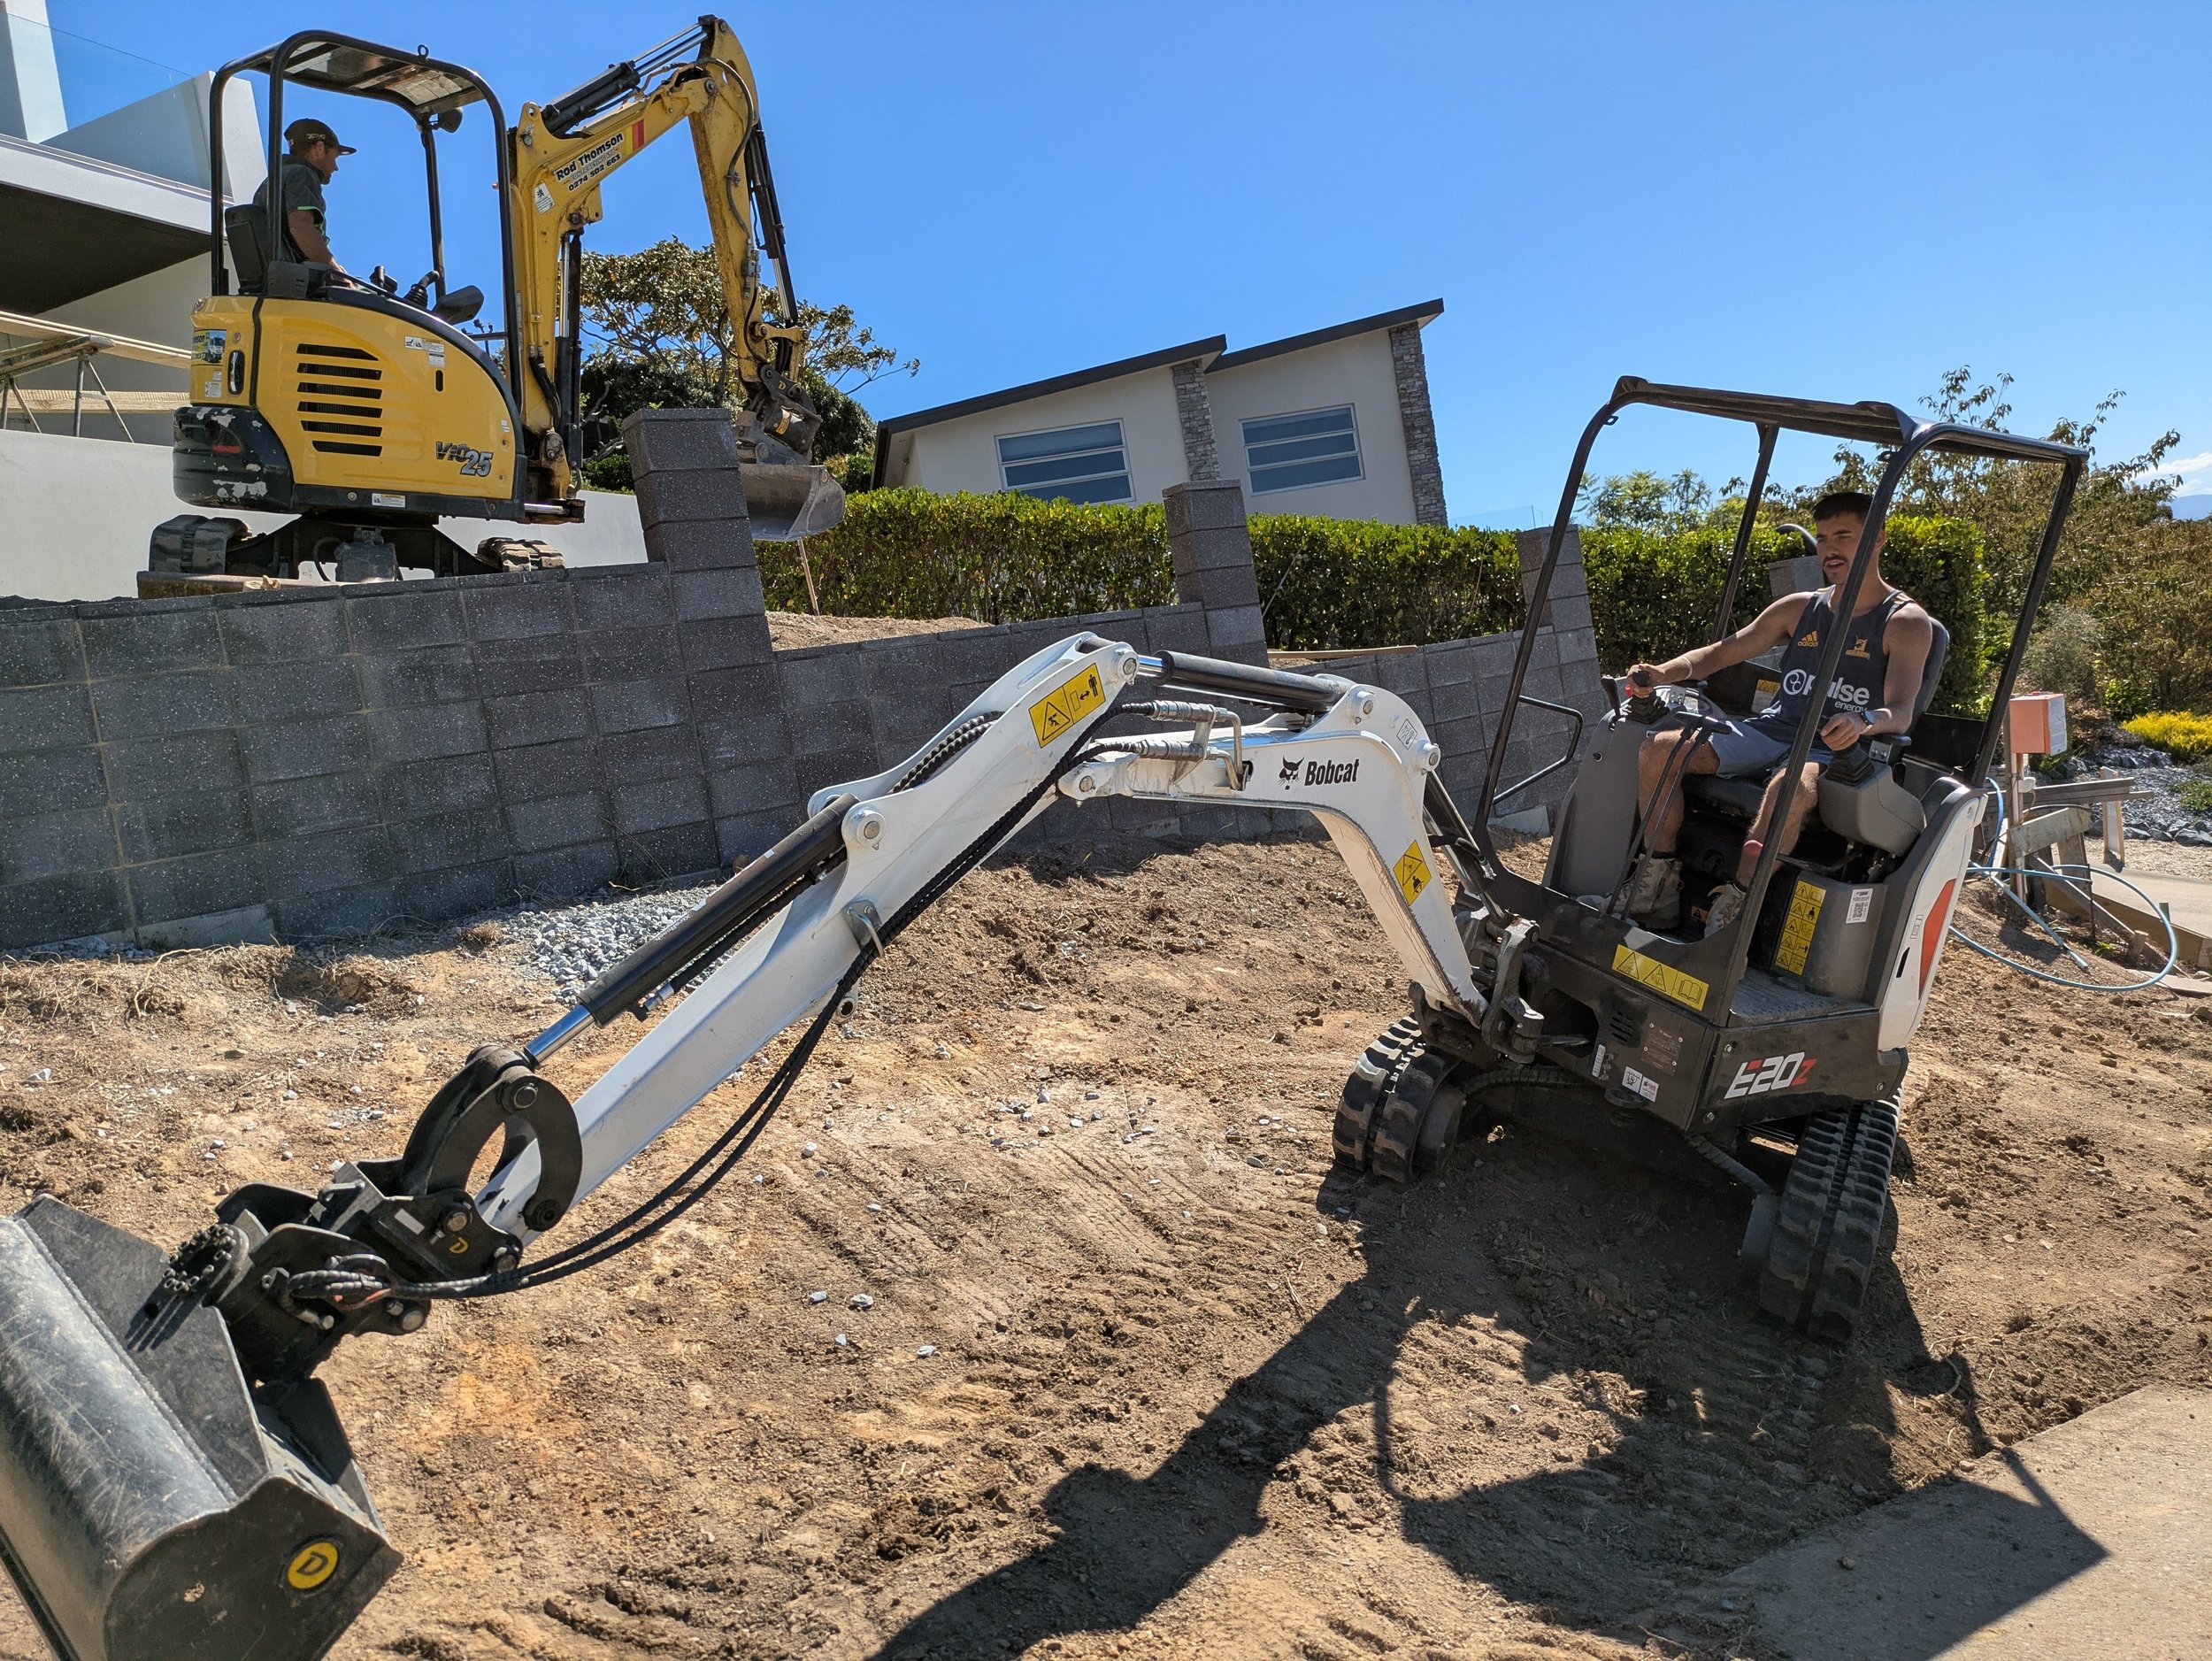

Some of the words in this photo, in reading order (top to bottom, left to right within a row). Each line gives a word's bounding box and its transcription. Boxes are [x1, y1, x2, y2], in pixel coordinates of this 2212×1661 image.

[556, 161, 577, 181] Rod
[578, 133, 624, 166] Thomson
[568, 175, 588, 191] 0274
[589, 164, 605, 178] 502
[606, 154, 621, 166] 663
[1304, 758, 1359, 787] Bobcat
[296, 1550, 329, 1576] D
